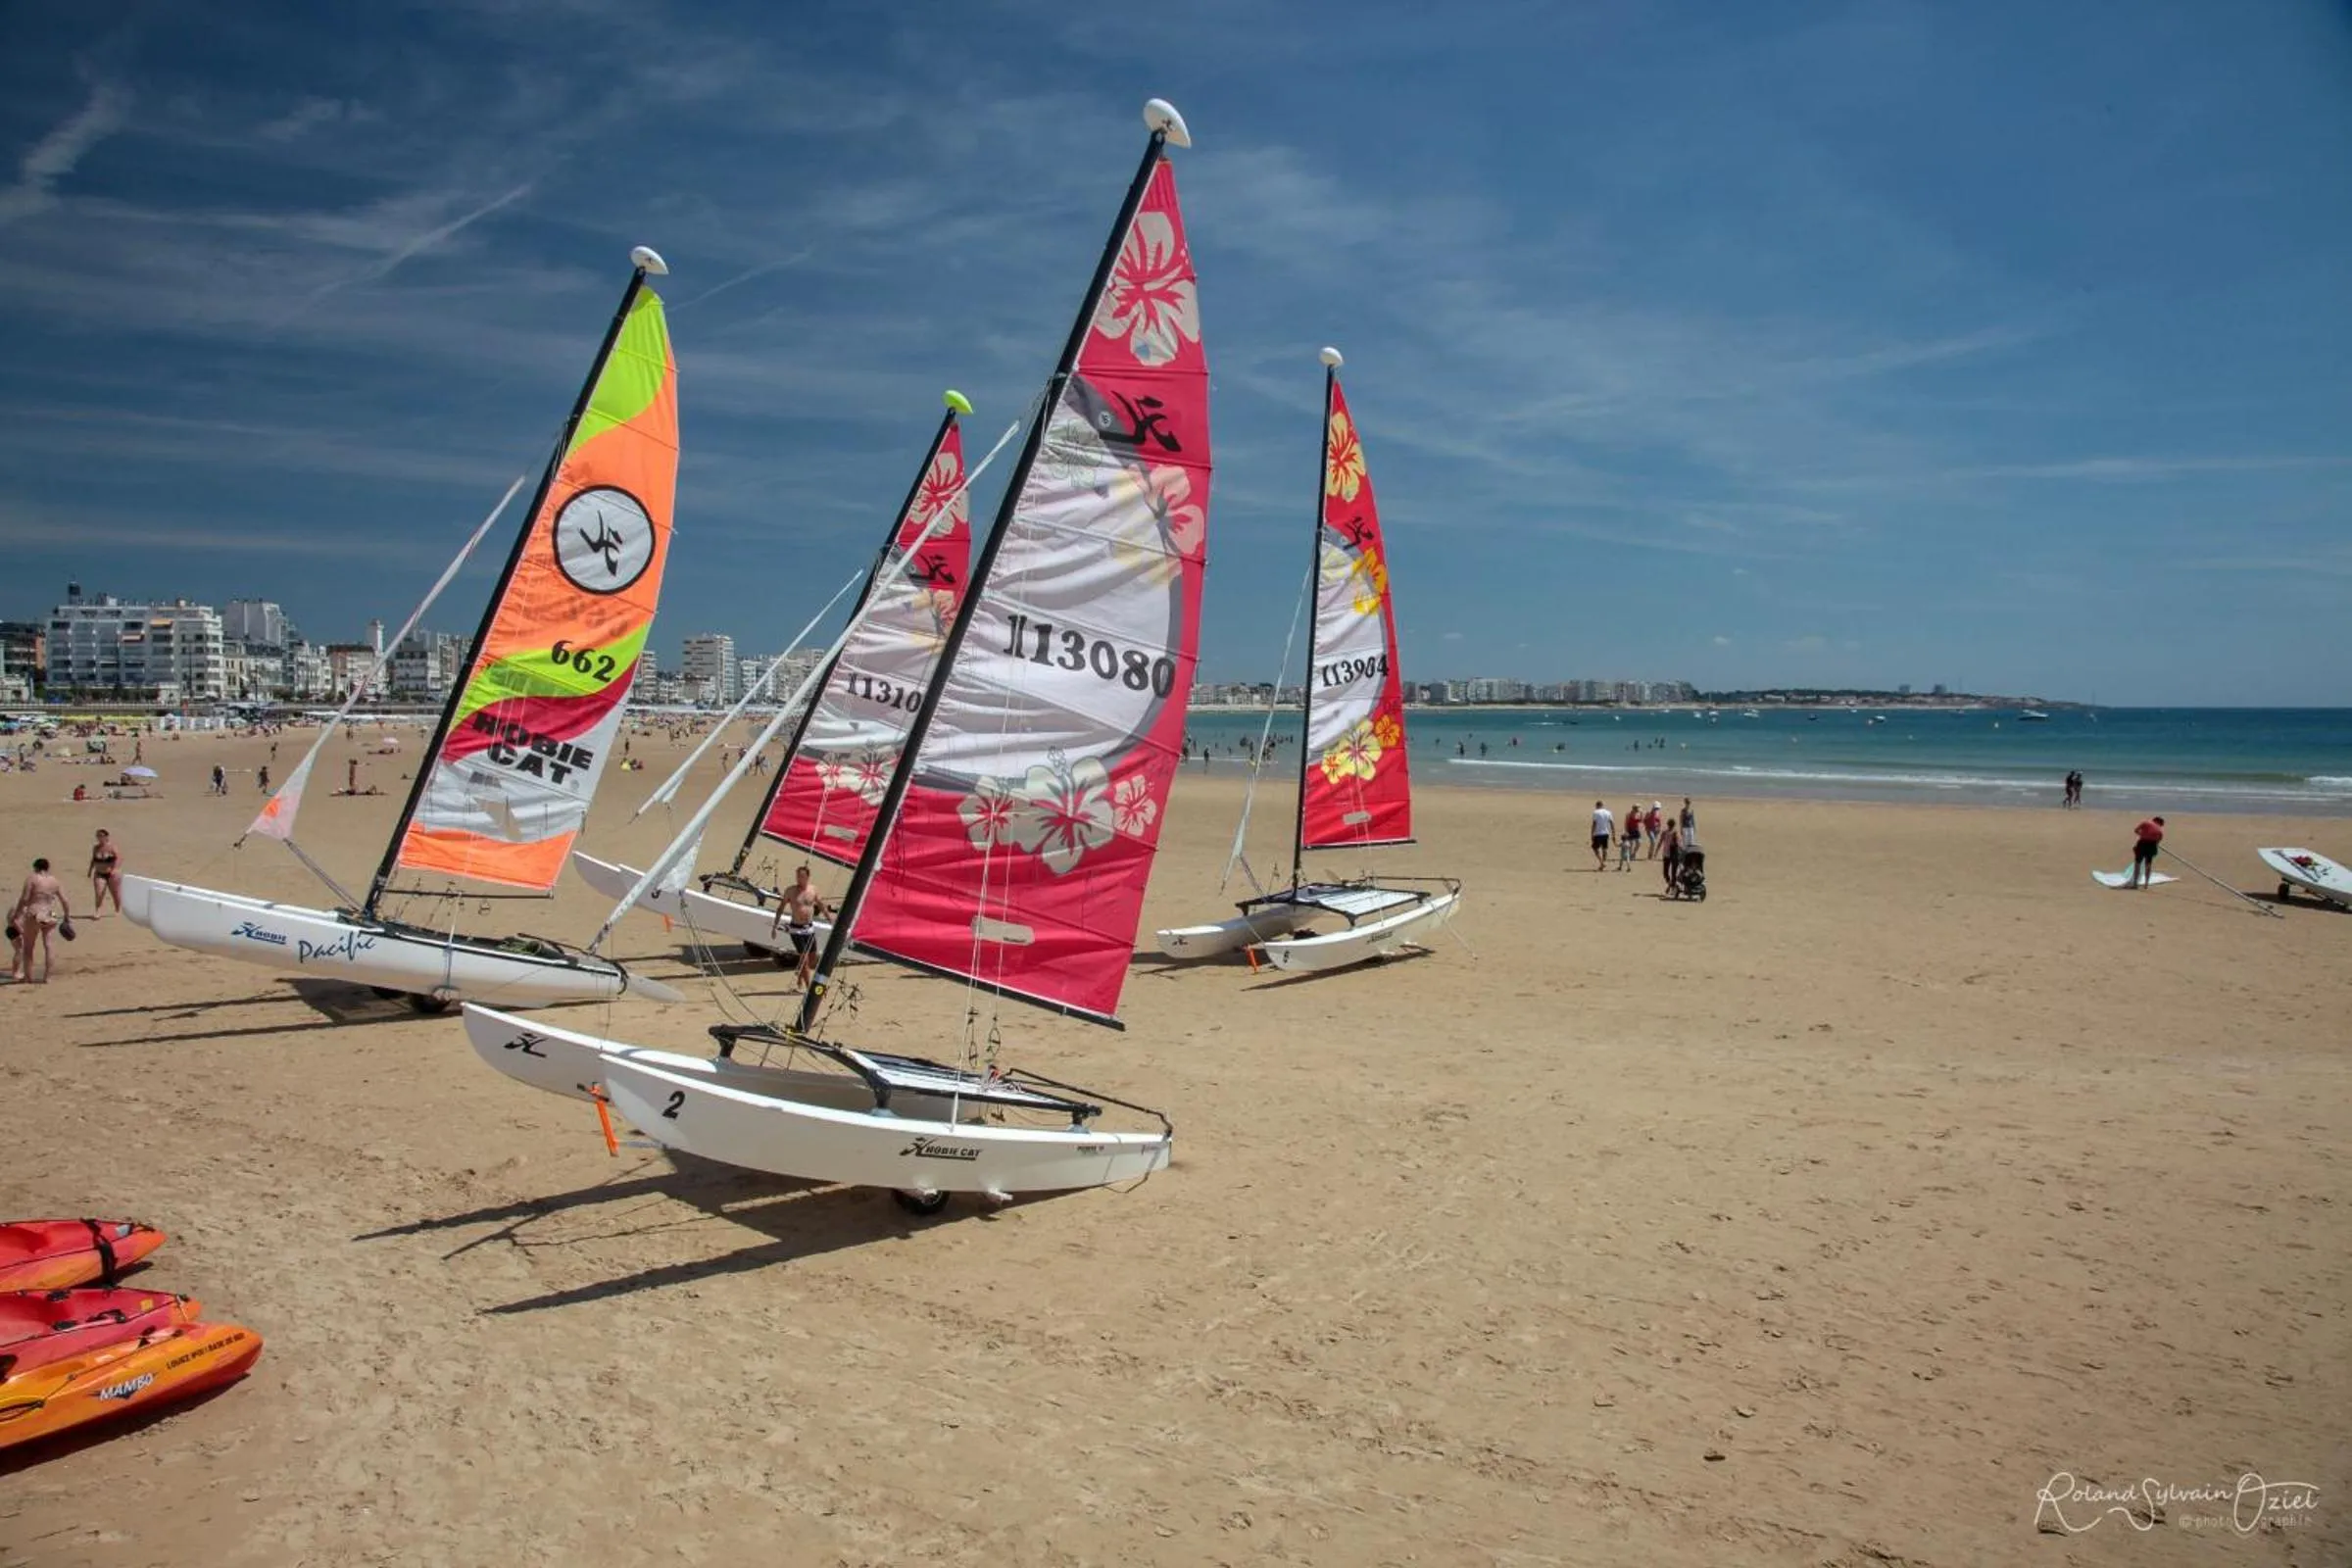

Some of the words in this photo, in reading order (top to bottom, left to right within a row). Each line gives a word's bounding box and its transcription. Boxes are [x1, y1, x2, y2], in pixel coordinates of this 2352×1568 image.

[551, 640, 616, 683] 662
[1003, 614, 1176, 699] 113080
[1322, 654, 1390, 687] 113904
[472, 711, 594, 771] HOBIE
[488, 743, 572, 785] CAT
[298, 930, 377, 964] Pacific
[662, 1090, 686, 1120] 2
[925, 1145, 959, 1156] HOBIE
[960, 1148, 984, 1157] CAT
[100, 1372, 154, 1401] MAMBO
